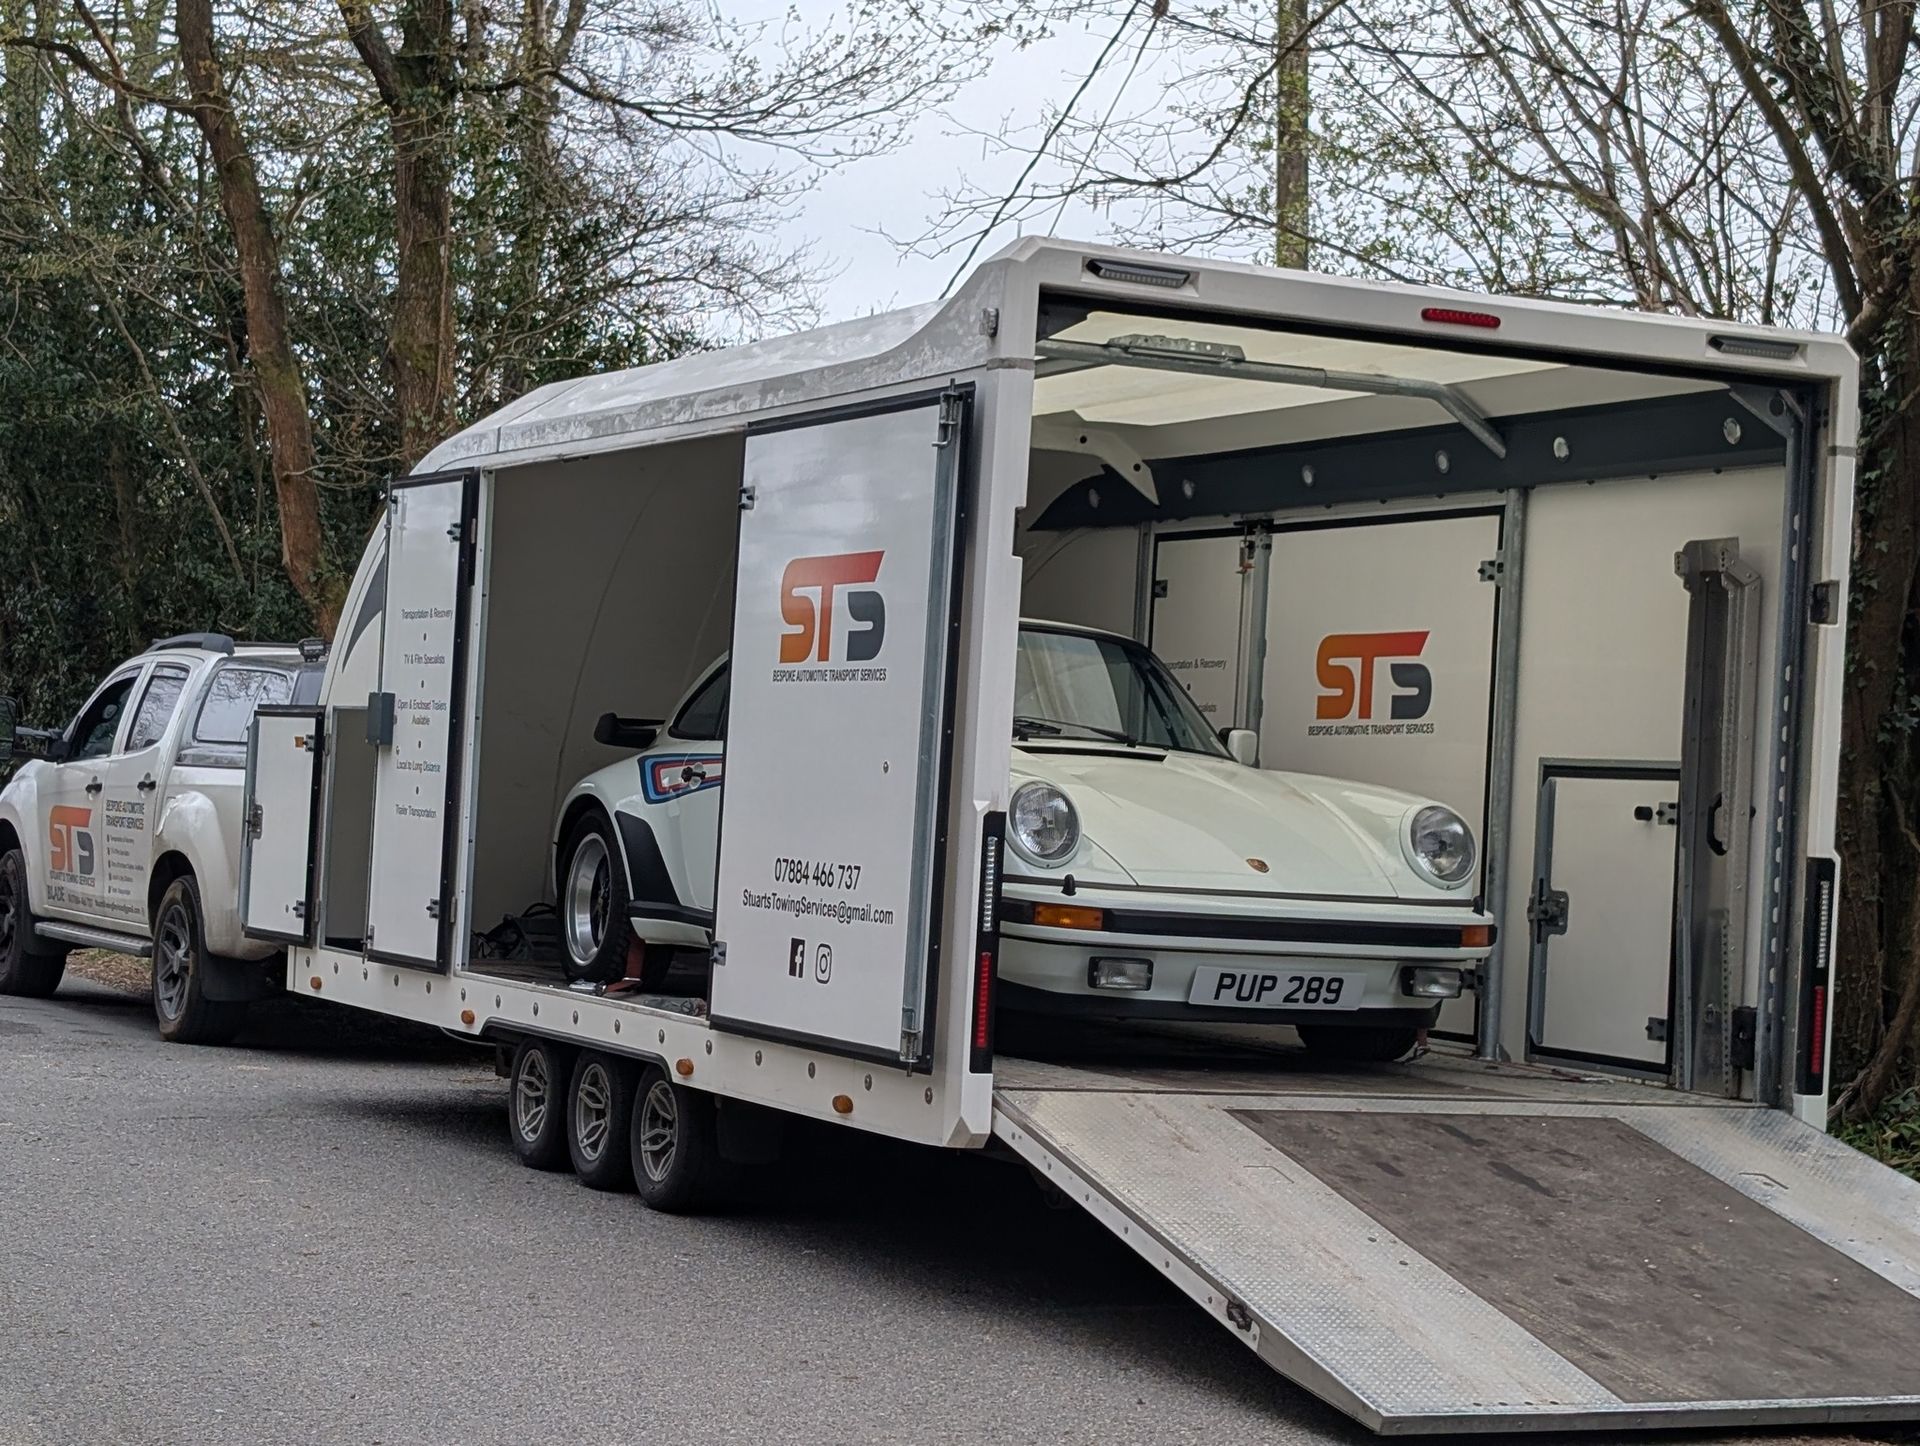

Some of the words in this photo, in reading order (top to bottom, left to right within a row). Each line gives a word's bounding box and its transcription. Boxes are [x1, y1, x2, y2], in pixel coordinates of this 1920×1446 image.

[401, 608, 429, 620] Transportation
[434, 607, 453, 621] Recovery
[779, 550, 885, 664] STS
[404, 654, 410, 664] TV
[415, 653, 423, 665] Film
[424, 653, 445, 665] Specialists
[1200, 658, 1226, 671] Recovery
[773, 669, 796, 682] BESPOKE
[796, 669, 828, 682] AUTOMOTIVE
[829, 668, 860, 682] TRANSPORT
[861, 667, 887, 682] SERVICES
[1316, 631, 1432, 720] STS
[398, 699, 408, 711] Open
[1308, 725, 1334, 736] BESPOKE
[1334, 724, 1369, 736] AUTOMOTIVE
[1371, 723, 1405, 735] TRANSPORT
[1405, 722, 1434, 735] SERVICES
[412, 761, 422, 774] Long
[408, 805, 437, 819] Transportation
[49, 805, 95, 876] STS
[774, 857, 810, 885] 07884
[813, 862, 834, 888] 466
[838, 865, 861, 890] 737
[742, 888, 894, 925] StuartsTowingServices@gmail.com
[1213, 972, 1278, 1003] PUP
[1282, 976, 1344, 1004] 289
